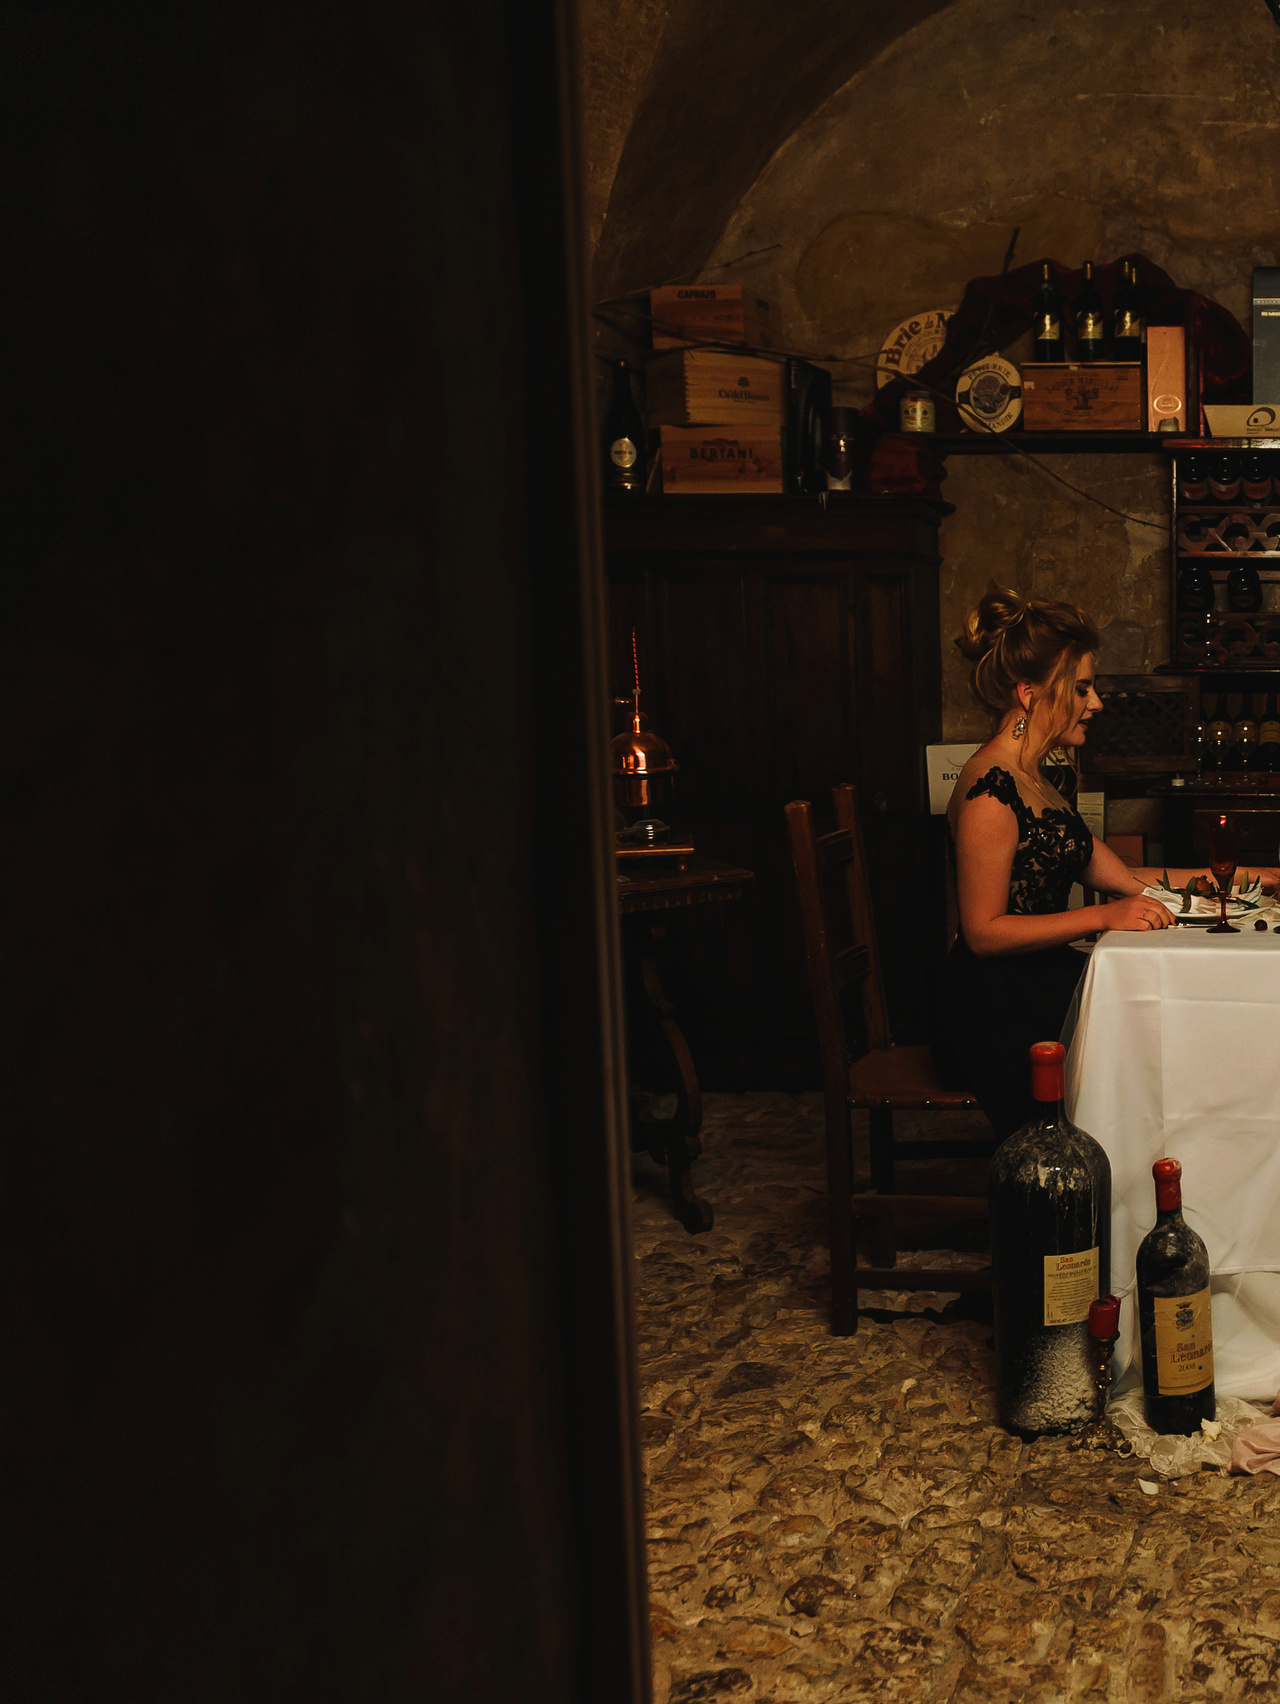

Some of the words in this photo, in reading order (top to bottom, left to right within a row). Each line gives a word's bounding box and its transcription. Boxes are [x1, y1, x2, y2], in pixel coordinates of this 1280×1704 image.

[886, 320, 922, 367] Brie
[689, 447, 753, 459] BERTANI
[1056, 1258, 1091, 1271] Leonardo
[1176, 1342, 1196, 1353] San
